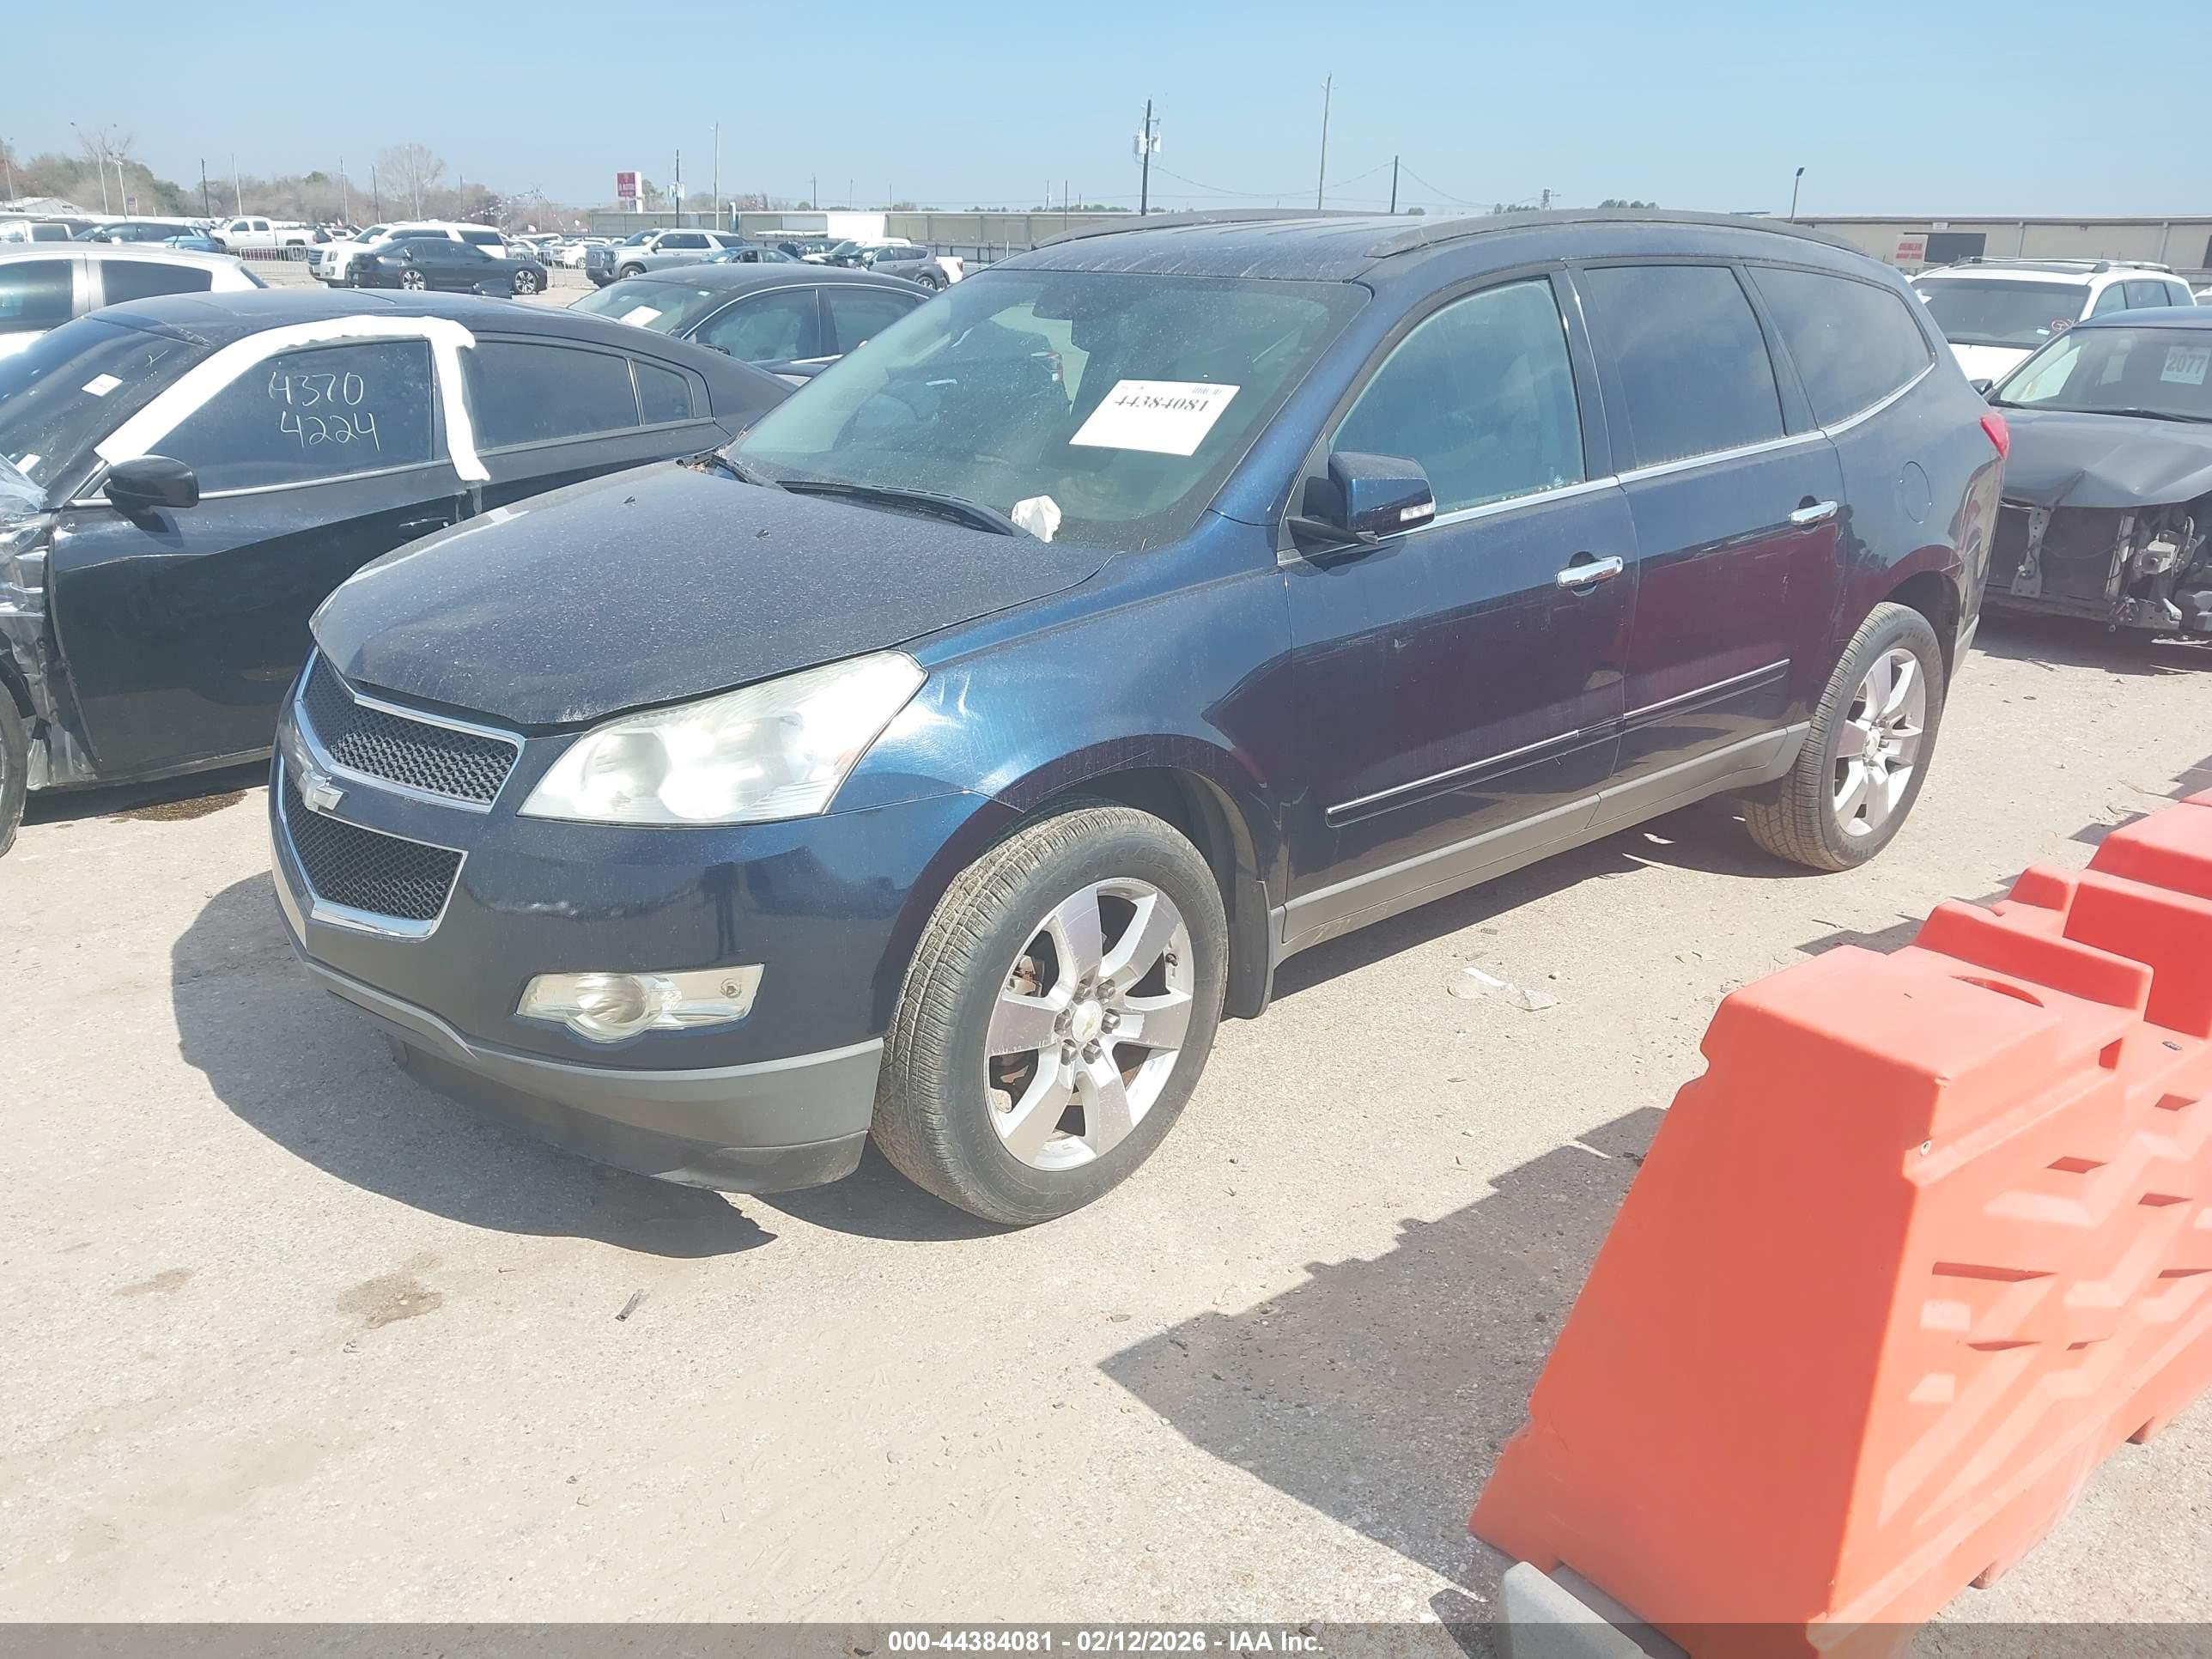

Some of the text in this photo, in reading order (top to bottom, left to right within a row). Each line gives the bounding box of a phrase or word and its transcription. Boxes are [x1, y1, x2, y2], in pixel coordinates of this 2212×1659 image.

[2166, 354, 2206, 374] 2077
[269, 371, 364, 406] 4370
[1115, 395, 1208, 411] 44384081
[280, 410, 380, 452] 4224
